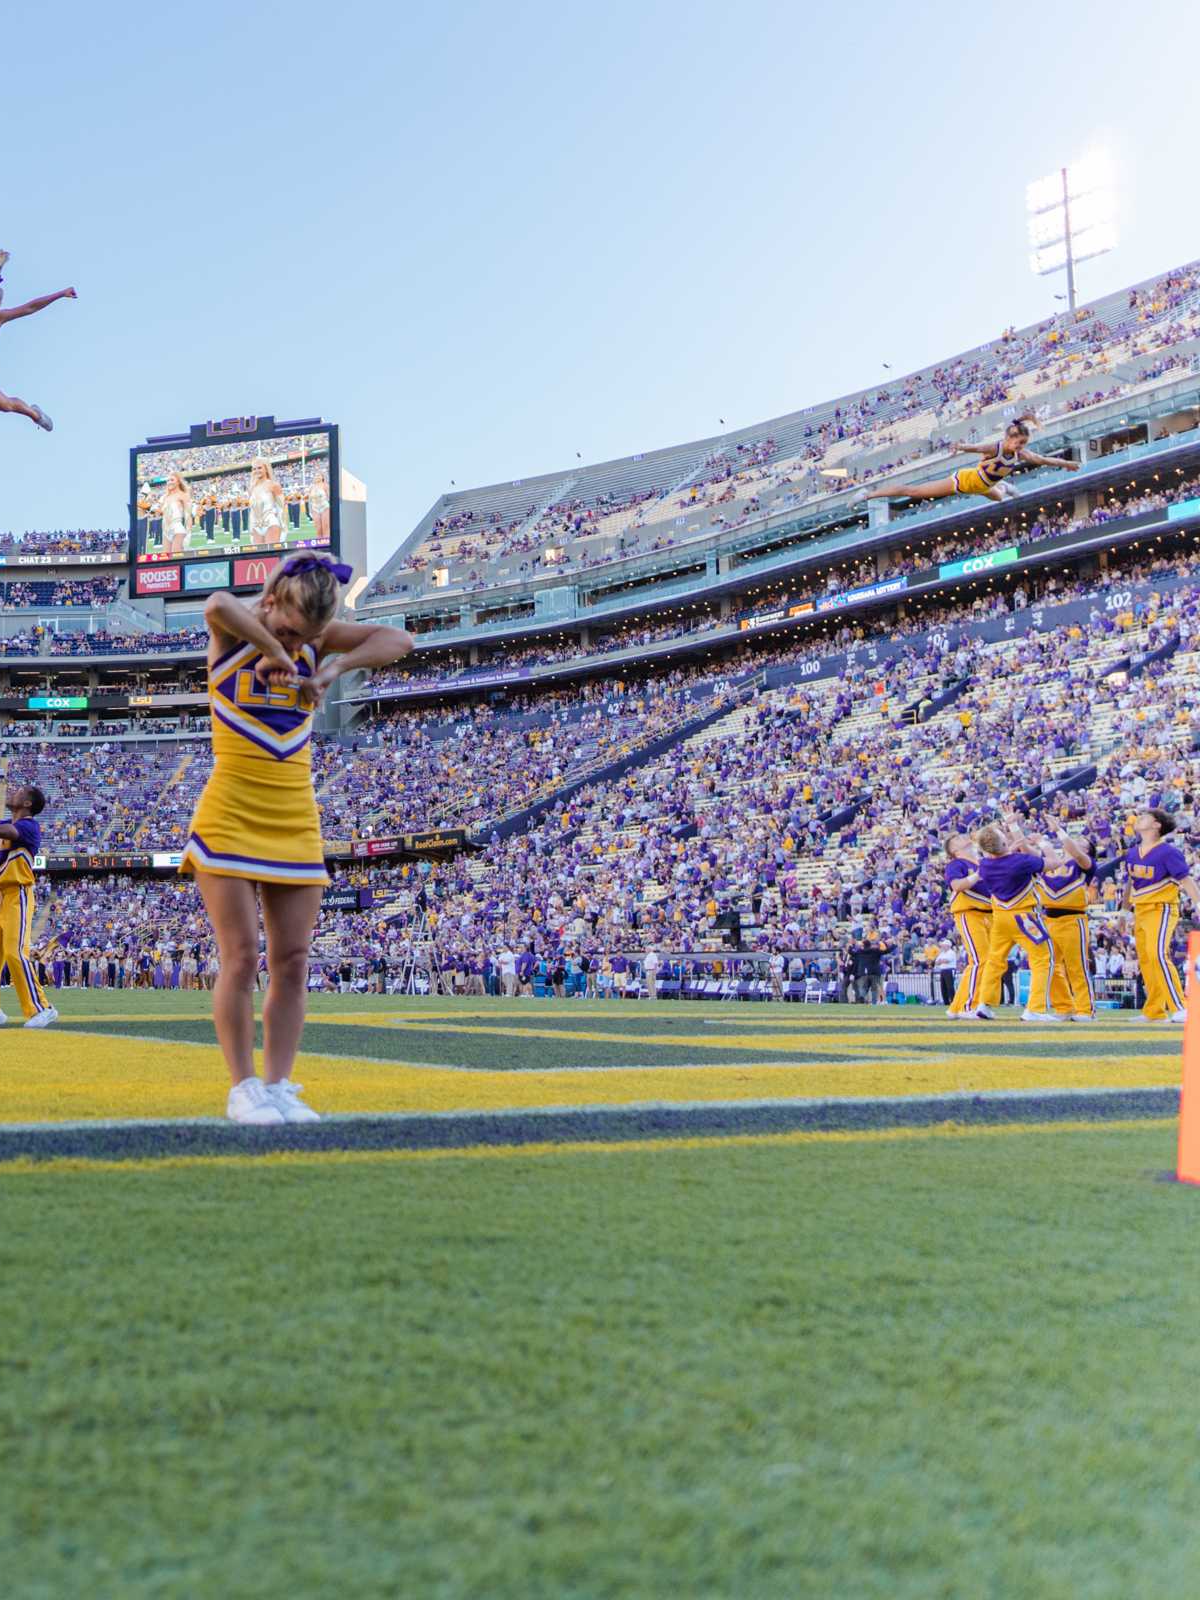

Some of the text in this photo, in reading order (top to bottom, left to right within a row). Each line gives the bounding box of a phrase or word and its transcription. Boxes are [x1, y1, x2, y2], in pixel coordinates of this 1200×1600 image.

[206, 415, 258, 437] LSU
[18, 556, 39, 564] CHAT
[962, 556, 994, 575] COX
[139, 569, 178, 584] ROUSES
[187, 566, 227, 584] COX
[847, 590, 876, 602] LOUISIANA
[876, 582, 901, 595] LOTTERY
[1105, 591, 1132, 610] 102
[800, 660, 820, 676] 100
[46, 697, 70, 708] COX
[129, 696, 152, 706] LSU
